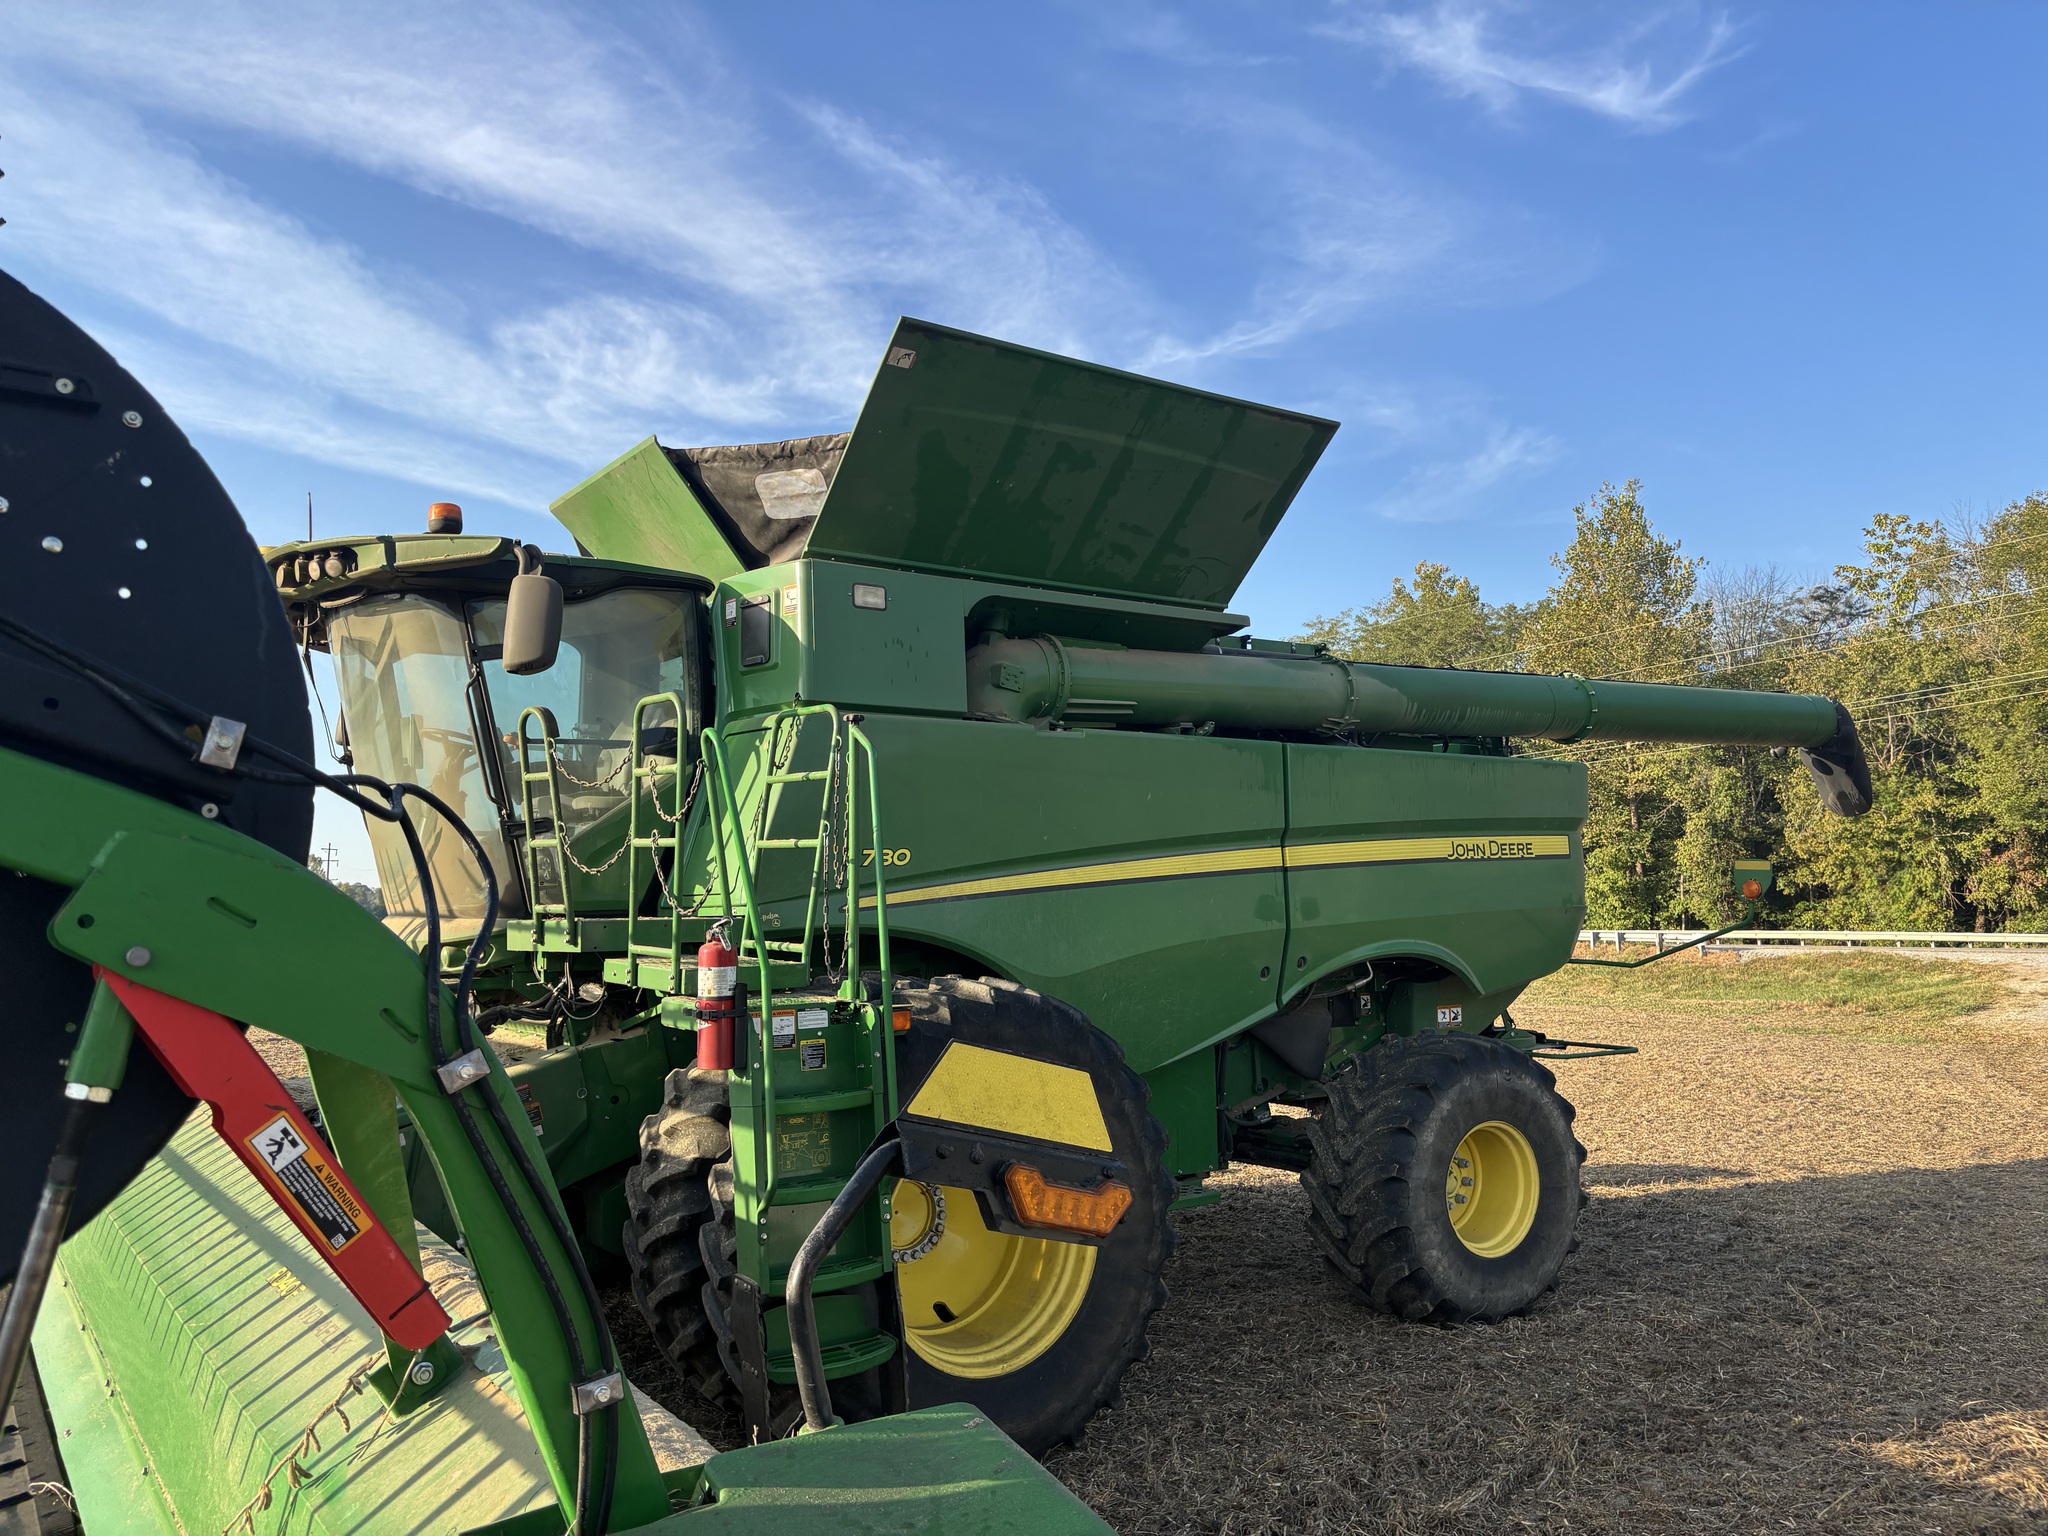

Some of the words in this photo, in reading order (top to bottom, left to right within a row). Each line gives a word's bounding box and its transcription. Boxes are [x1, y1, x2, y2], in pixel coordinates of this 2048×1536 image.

[1447, 841, 1486, 857] JOHN
[1488, 841, 1534, 857] DEERE
[324, 1173, 362, 1219] WARNING
[266, 1266, 307, 1298] RD40F
